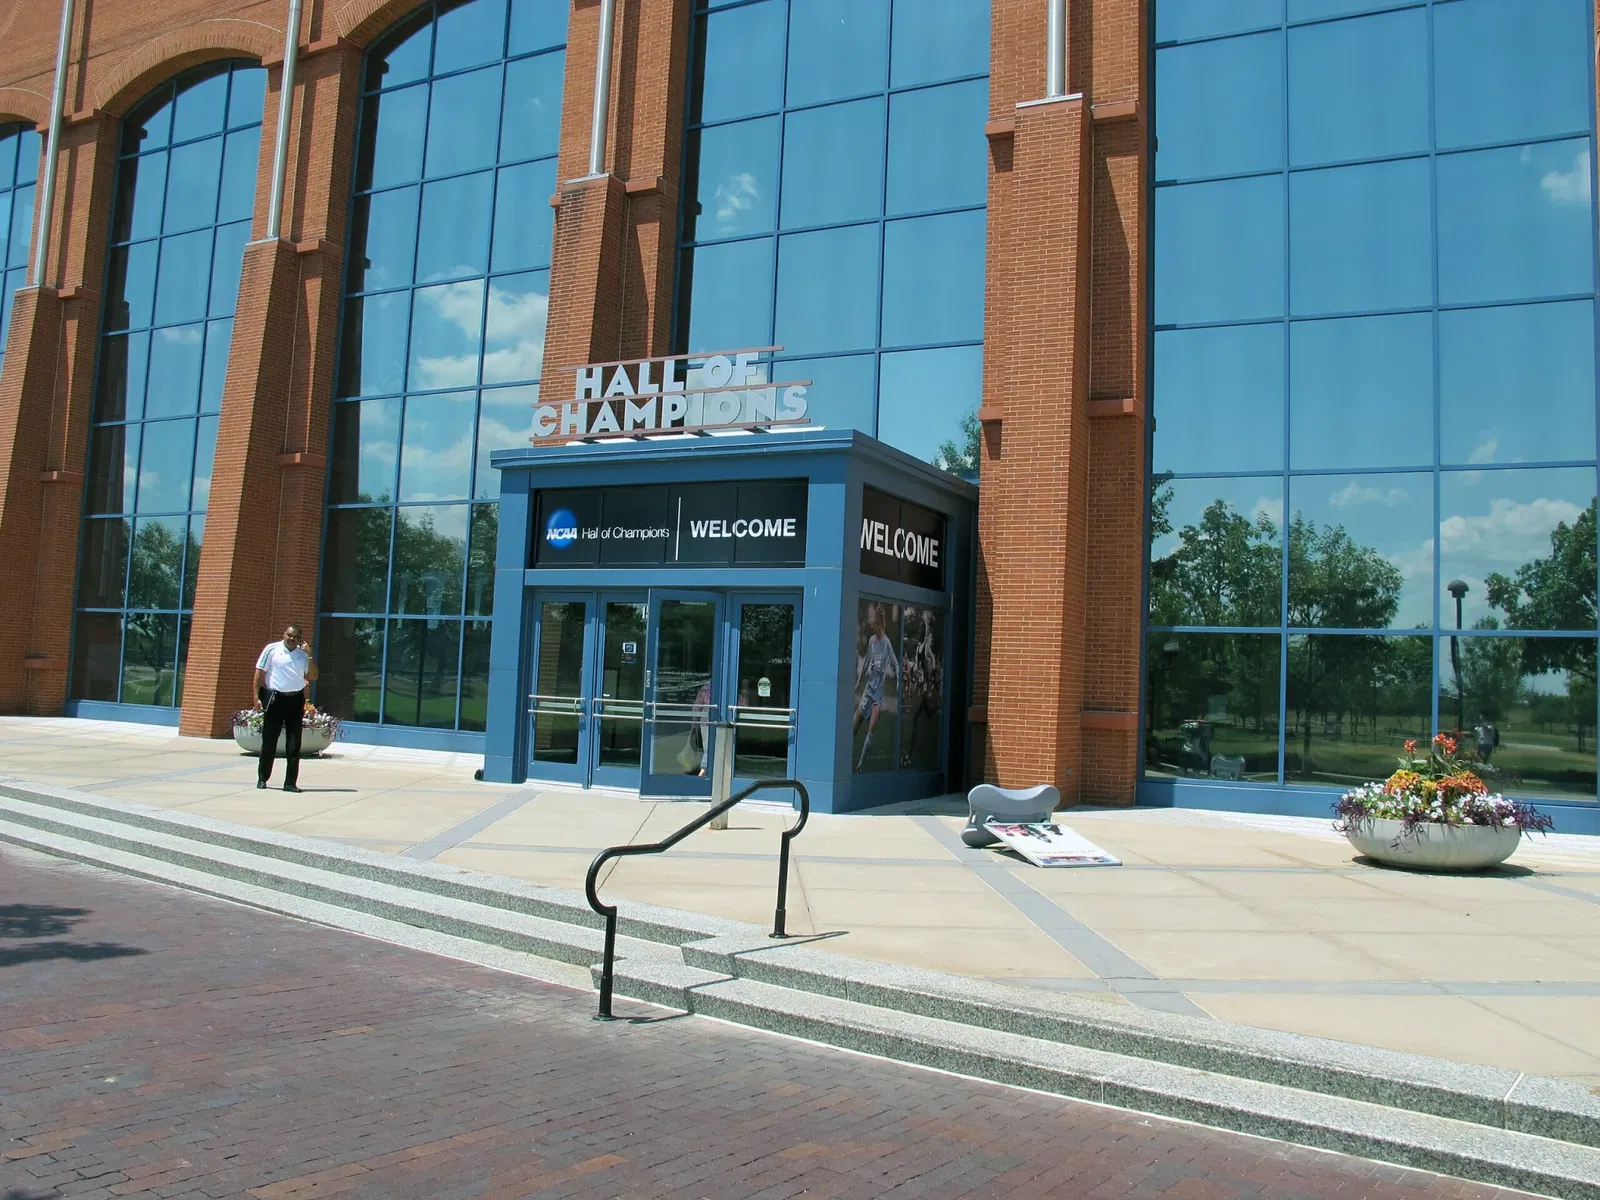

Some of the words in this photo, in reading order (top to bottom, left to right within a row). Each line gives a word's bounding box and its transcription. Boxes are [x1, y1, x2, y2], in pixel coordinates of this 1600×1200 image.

[575, 360, 684, 399] HALL
[702, 352, 759, 388] OF
[532, 385, 808, 437] CHAMPIONS
[546, 527, 578, 541] NCAA
[582, 527, 599, 540] Hal
[600, 527, 612, 539] of
[612, 526, 670, 541] Champions
[690, 518, 796, 539] WELCOME
[860, 518, 939, 568] WELCOME
